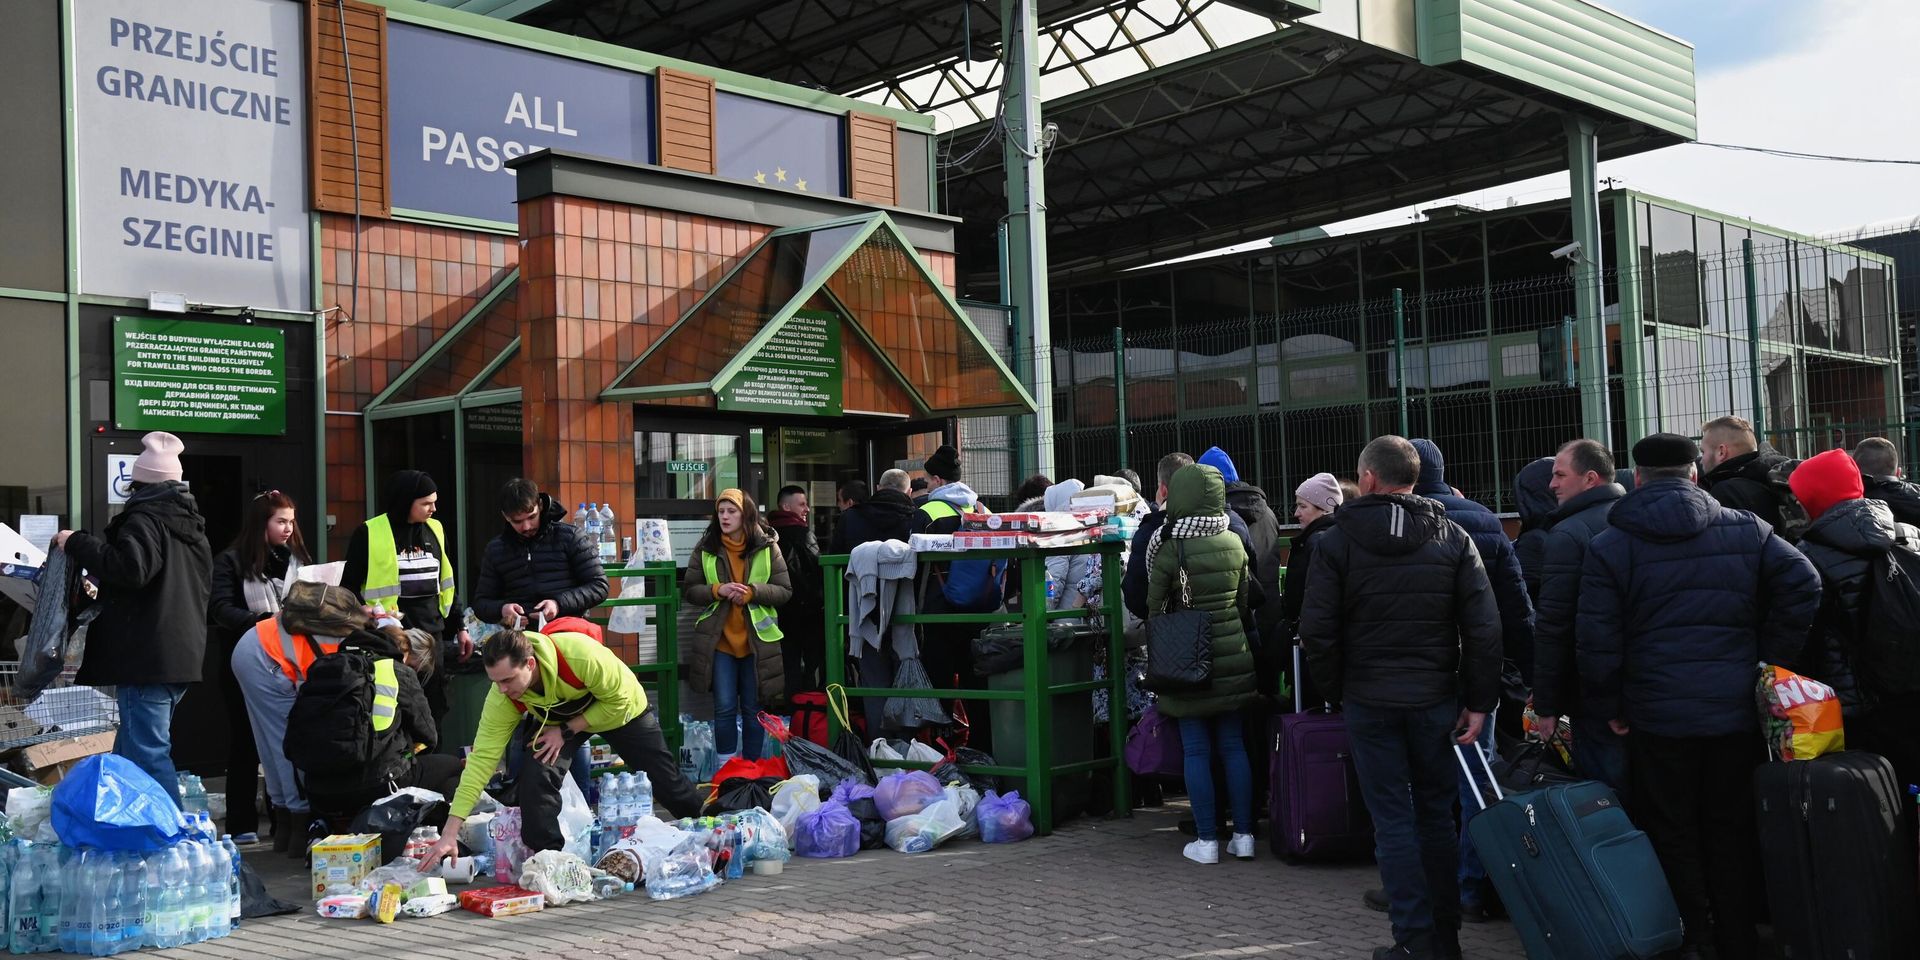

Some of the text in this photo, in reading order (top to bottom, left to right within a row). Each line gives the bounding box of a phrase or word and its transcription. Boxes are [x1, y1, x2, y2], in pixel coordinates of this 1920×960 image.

[110, 17, 278, 78] PRZEJŚCIE
[96, 65, 290, 126] GRANICZNE
[504, 92, 578, 137] ALL
[422, 125, 549, 176] PASS
[120, 166, 275, 214] MEDYKA-
[123, 216, 274, 262] SZEGINIE
[125, 332, 157, 341] WEJŚCIE
[169, 335, 202, 344] BUDYNKU
[203, 337, 242, 347] WYŁĄCZNIE
[257, 341, 275, 349] OSÓB
[126, 342, 199, 353] PRZEKRACZAJĄCYCH
[199, 347, 229, 356] GRANICĘ
[138, 352, 161, 360] ENTRY
[188, 356, 220, 364] BUILDING
[221, 357, 265, 366] EXCLUSIVELY
[127, 360, 141, 368] FOR
[143, 361, 190, 371] TRAWELLERS
[208, 365, 230, 373] CROSS
[245, 368, 274, 376] BORDER.
[124, 379, 142, 387] ВХІД
[143, 380, 181, 389] ВІКЛЮЧНО
[182, 382, 197, 390] ДЛЯ
[228, 385, 277, 394] ПЕРЕТИНАЮТЬ
[165, 391, 210, 399] ДЕРЖАВНИЙ
[138, 399, 160, 407] ДВЕРІ
[161, 400, 189, 408] БУДУТЬ
[240, 404, 265, 412] ТІЛЬКИ
[143, 408, 194, 418] НАТИСНЕТЬСЯ
[671, 462, 704, 471] WEJŚCIE
